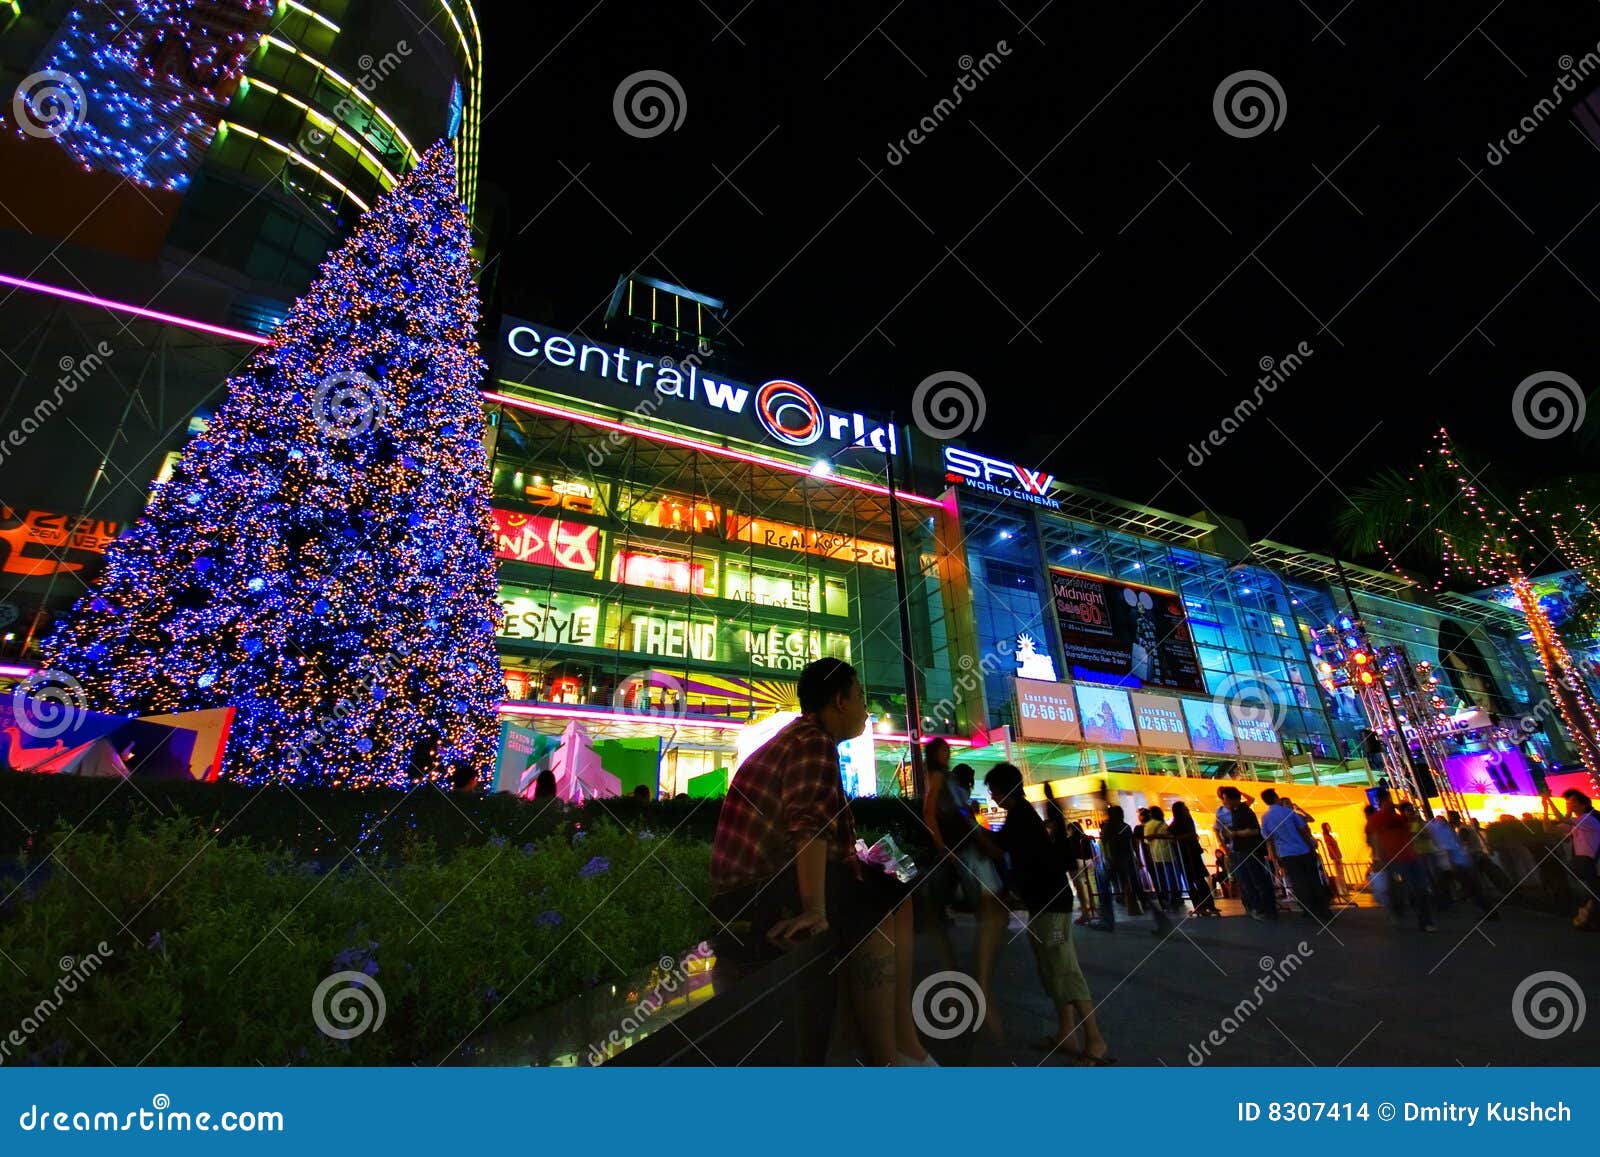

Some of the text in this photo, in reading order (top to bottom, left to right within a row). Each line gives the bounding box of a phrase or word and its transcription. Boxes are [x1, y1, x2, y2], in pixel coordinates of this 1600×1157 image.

[966, 477, 1061, 509] WORLD CINEMA
[1053, 584, 1104, 606] Midnight
[631, 616, 717, 661] TREND
[745, 628, 820, 661] MEGA
[751, 654, 810, 671] STOR
[1021, 703, 1075, 722] 02:56:50
